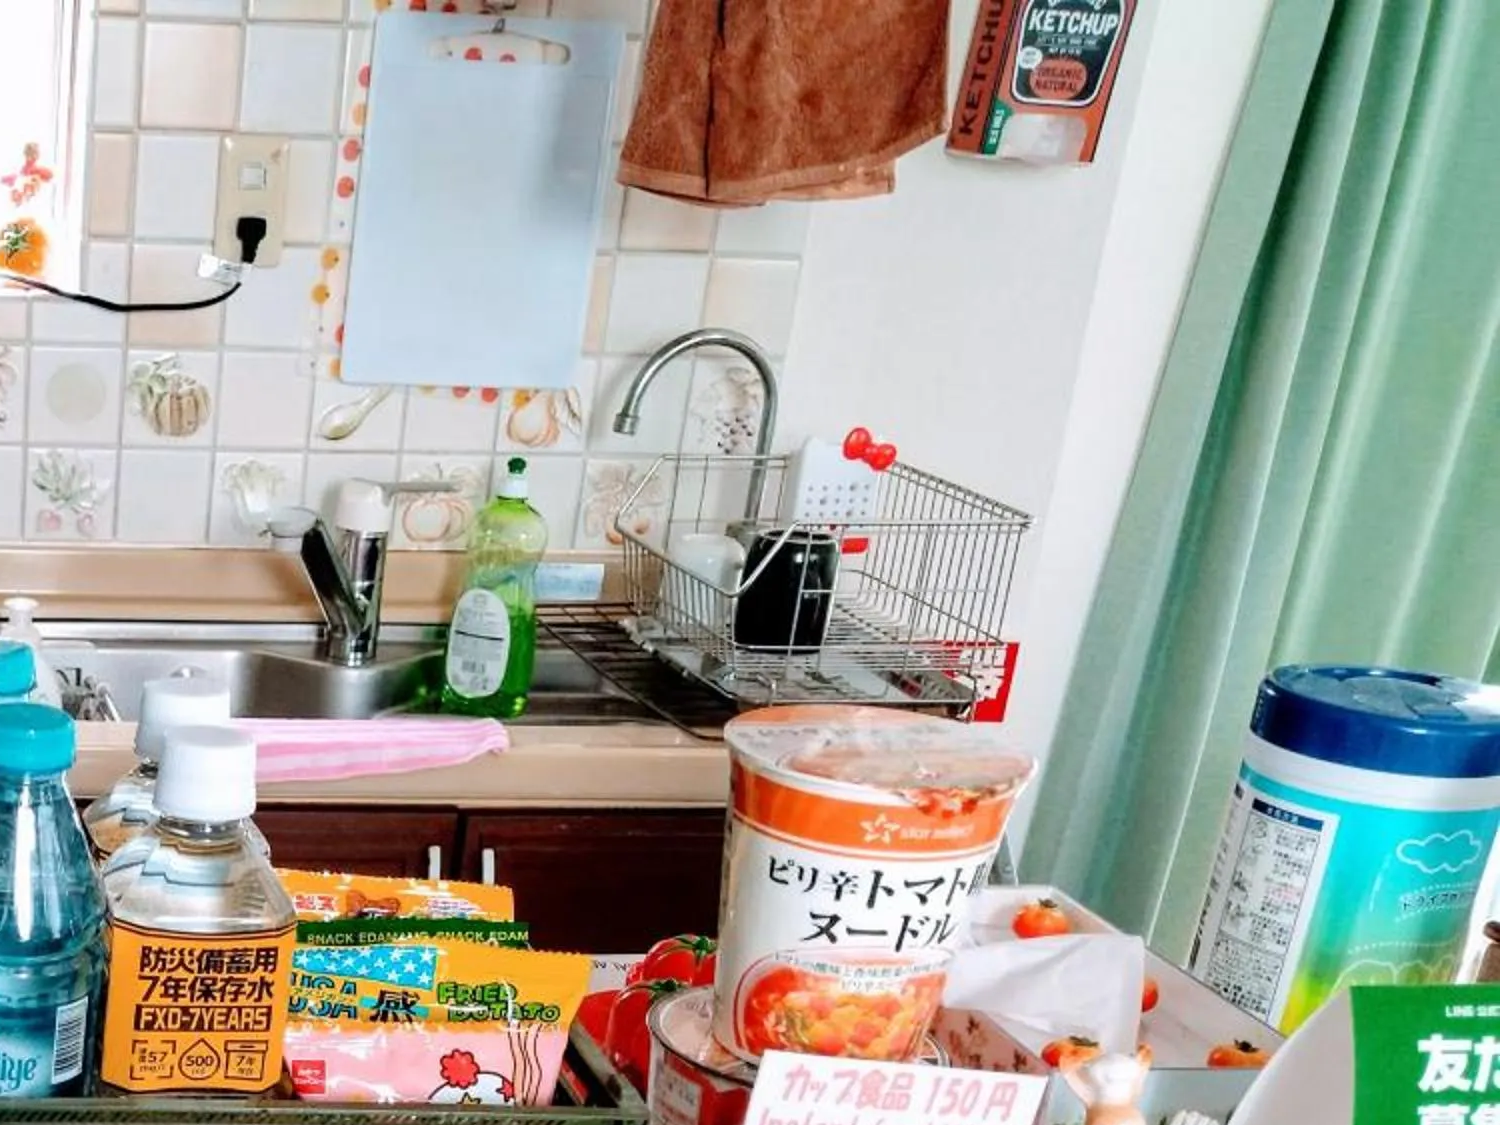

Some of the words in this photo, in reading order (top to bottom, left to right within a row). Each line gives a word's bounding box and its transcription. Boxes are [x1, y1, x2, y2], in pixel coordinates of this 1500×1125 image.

[1028, 8, 1119, 36] KETCHUP
[1033, 78, 1078, 92] NATURAL
[307, 933, 354, 945] SNACK
[801, 911, 956, 952] ヌードル
[140, 946, 279, 974] 防災備蓄用
[138, 975, 275, 1002] 7年保存水
[437, 981, 517, 1002] FRIED
[448, 1002, 560, 1022] POTATO
[185, 1055, 214, 1067] 500
[782, 1064, 915, 1112] カップ食品
